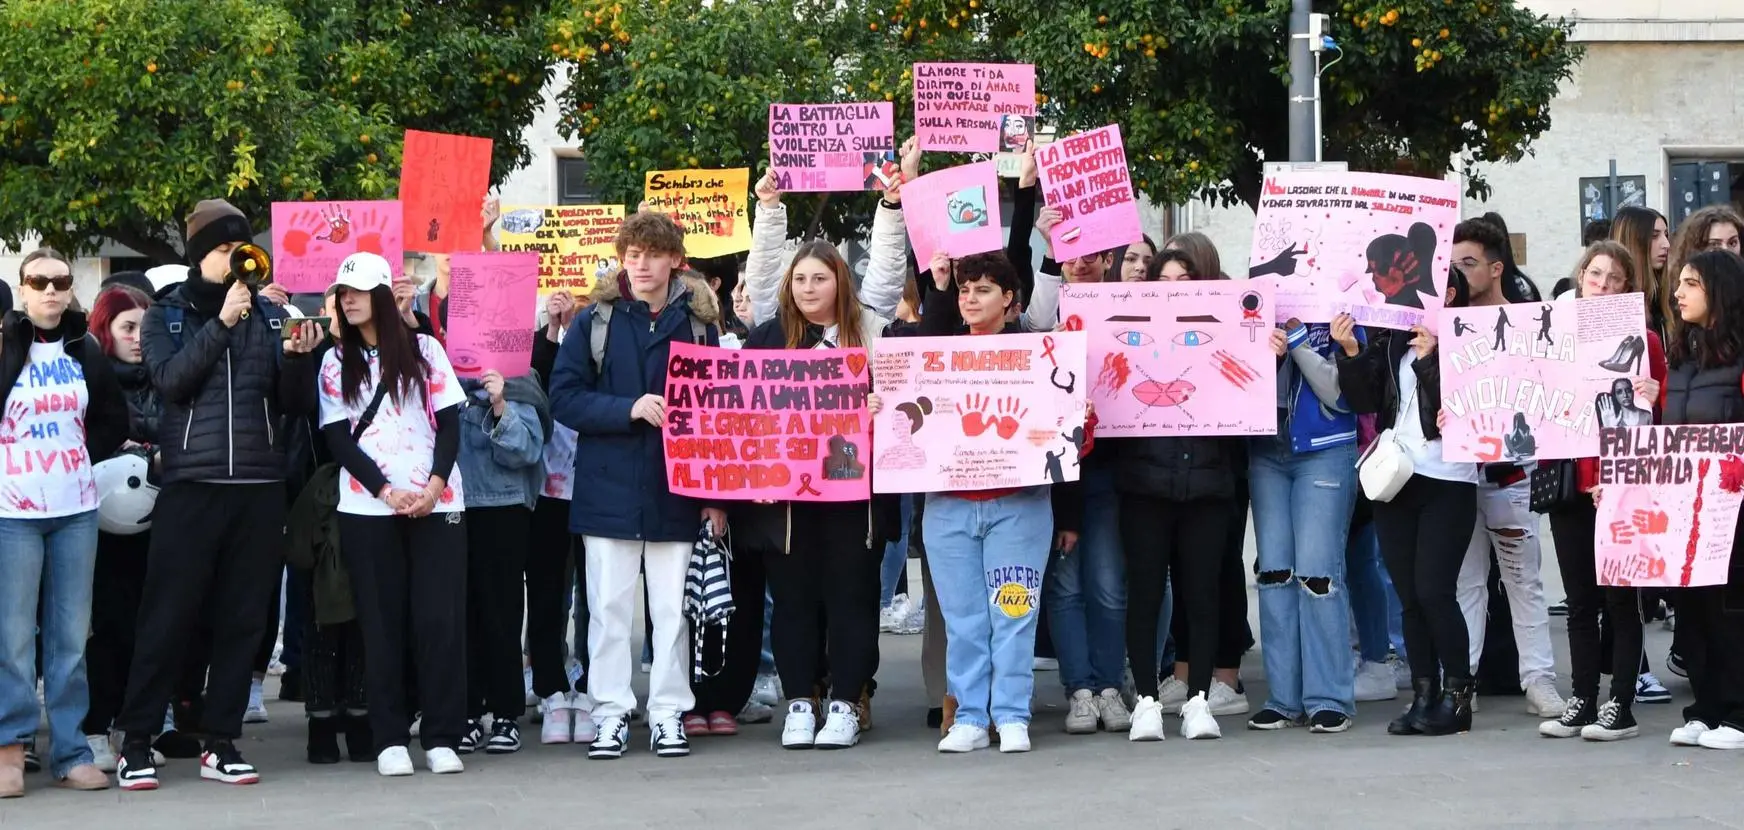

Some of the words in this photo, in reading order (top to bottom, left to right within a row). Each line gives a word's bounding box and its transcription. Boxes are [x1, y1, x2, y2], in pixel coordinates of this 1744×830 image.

[917, 66, 967, 78] L'AMORE
[989, 70, 1004, 79] DA
[918, 91, 942, 100] NON
[947, 91, 991, 101] QUELLO
[986, 82, 1020, 92] AMARE
[773, 106, 792, 120] LA
[799, 105, 880, 121] BATTAGLIA
[933, 101, 989, 112] VANTARE
[771, 122, 827, 136] CONTRO
[836, 122, 854, 135] LA
[919, 117, 953, 128] SULLA
[956, 118, 998, 130] PERSONA
[773, 138, 847, 152] VIOLENZA
[852, 136, 893, 151] SULLE
[928, 134, 968, 145] AMATA
[1040, 146, 1059, 167] LA
[1063, 130, 1111, 158] FERITA
[772, 152, 816, 167] DONNE
[824, 153, 862, 168] INIZIA
[1047, 147, 1124, 184] PROVOCATA
[649, 174, 703, 190] Sembra
[705, 179, 724, 189] che
[801, 171, 827, 188] ME
[1046, 188, 1061, 206] DA
[1063, 180, 1086, 200] UNA
[1088, 167, 1127, 193] PAROLA
[688, 192, 729, 205] davvero
[1078, 187, 1132, 215] GUARISCE
[1262, 199, 1293, 208] VENGA
[1296, 199, 1352, 208] SOVRASTATO
[1355, 201, 1368, 210] DAL
[1371, 202, 1413, 214] SILENZIO
[1287, 186, 1322, 195] LASCIARE
[1325, 186, 1339, 195] CHE
[1341, 187, 1348, 195] IL
[1351, 186, 1386, 198] RUMORE
[1389, 190, 1397, 200] DI
[1398, 193, 1416, 202] UNO
[1418, 195, 1458, 209] SCHIAFFO
[557, 208, 604, 217] VIOLENTO
[563, 219, 589, 227] UOMO
[535, 230, 555, 239] CHE
[557, 229, 580, 238] VUOL
[524, 243, 559, 254] PAROLA
[1351, 304, 1425, 327] NOVEMBRE
[922, 351, 945, 373] 25
[951, 349, 1032, 372] NOVEMBRE
[1449, 336, 1495, 375] NO
[1509, 330, 1576, 363] ALLA
[669, 355, 713, 380] COME
[717, 353, 740, 379] FAI
[742, 359, 758, 380] A
[761, 357, 844, 382] ROVINARE
[33, 391, 78, 415] NON
[668, 384, 692, 408] LA
[693, 382, 744, 409] VITA
[751, 385, 768, 410] A
[769, 384, 812, 411] UNA
[813, 383, 870, 410] DONNA
[1444, 375, 1596, 438] VIOLENZA
[30, 421, 60, 439] HA
[668, 410, 694, 436] SE
[700, 410, 714, 435] È
[714, 411, 782, 436] GRAZIE
[786, 414, 805, 434] A
[810, 413, 861, 435] UNA
[666, 438, 737, 460] DONNA
[740, 437, 781, 461] CHE
[786, 438, 818, 460] SEI
[1600, 427, 1632, 457] FAI
[1634, 427, 1658, 456] LA
[1663, 425, 1744, 455] DIFFERENZ
[673, 463, 701, 489] AL
[703, 463, 791, 491] MONDO
[1601, 459, 1613, 485] E
[987, 566, 1039, 589] LAKERS
